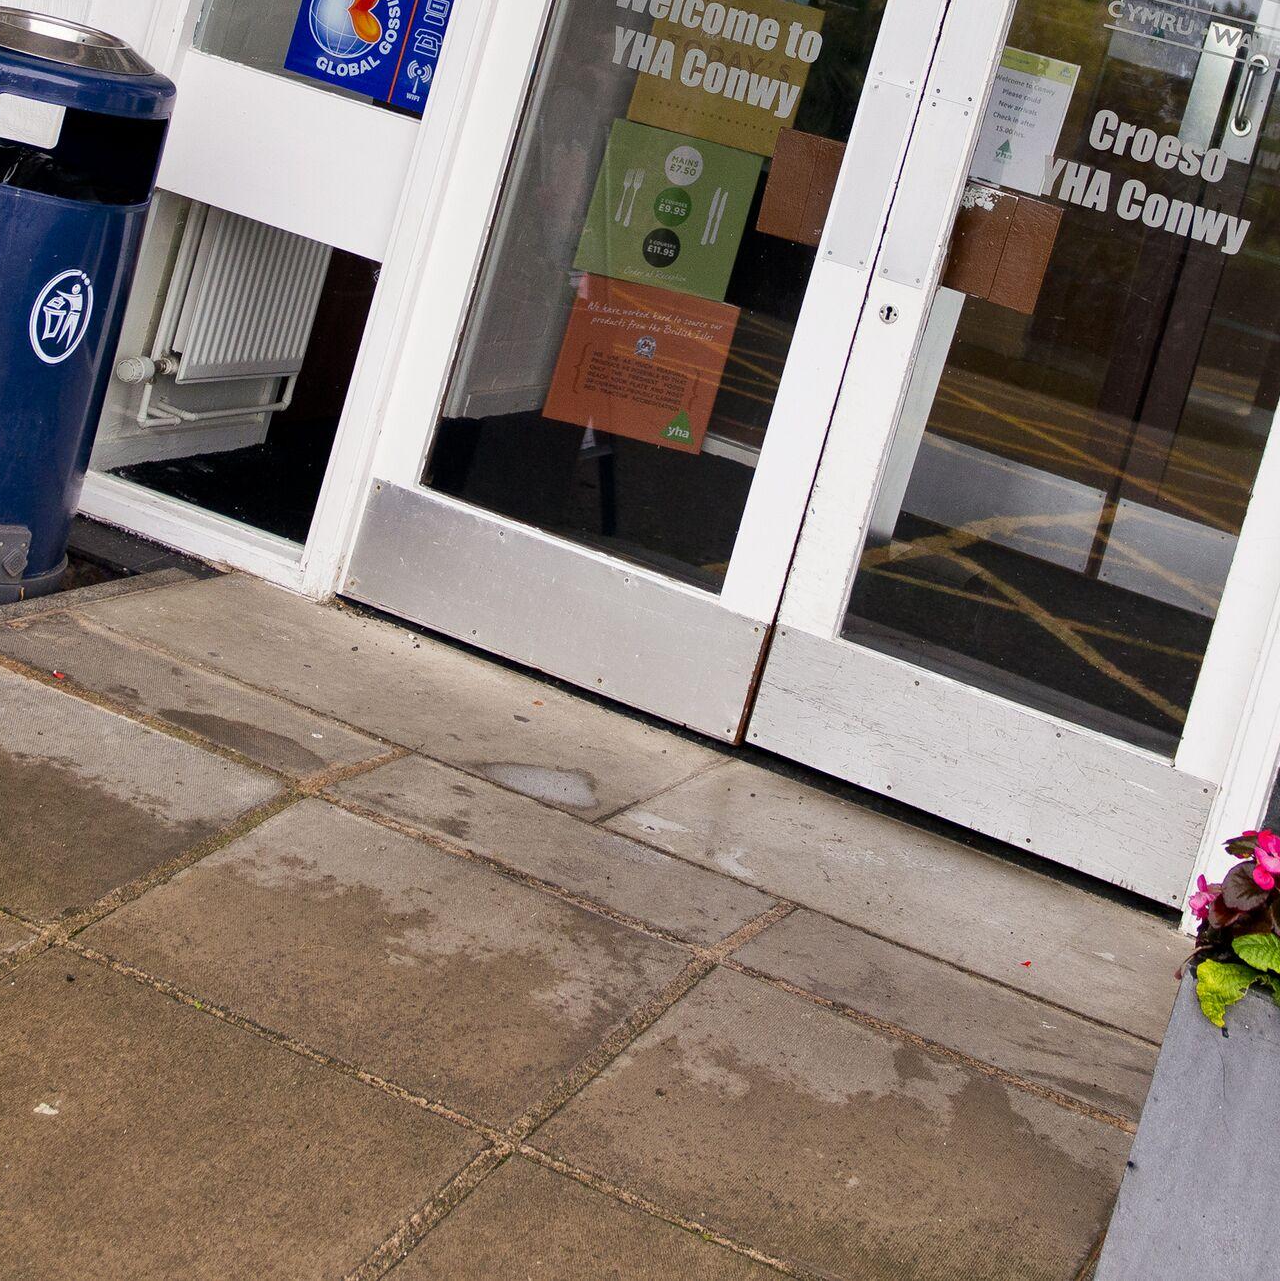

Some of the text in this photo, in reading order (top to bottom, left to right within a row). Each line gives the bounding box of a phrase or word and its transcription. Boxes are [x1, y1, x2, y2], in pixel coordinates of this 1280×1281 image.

[1108, 0, 1195, 36] CYMRU
[784, 21, 823, 63] to
[316, 55, 381, 77] GLOBAL
[612, 25, 801, 119] YHA Conwy
[996, 73, 1025, 88] Welcome
[1026, 81, 1033, 89] to
[998, 100, 1012, 109] New
[993, 111, 1012, 122] Check
[1088, 109, 1228, 183] Croeso
[672, 156, 699, 168] MAINS
[670, 164, 697, 177] £7.50
[658, 204, 686, 217] £9.95
[1041, 154, 1251, 256] YHA Conwy
[647, 245, 675, 257] £11.95
[667, 426, 690, 439] yha
